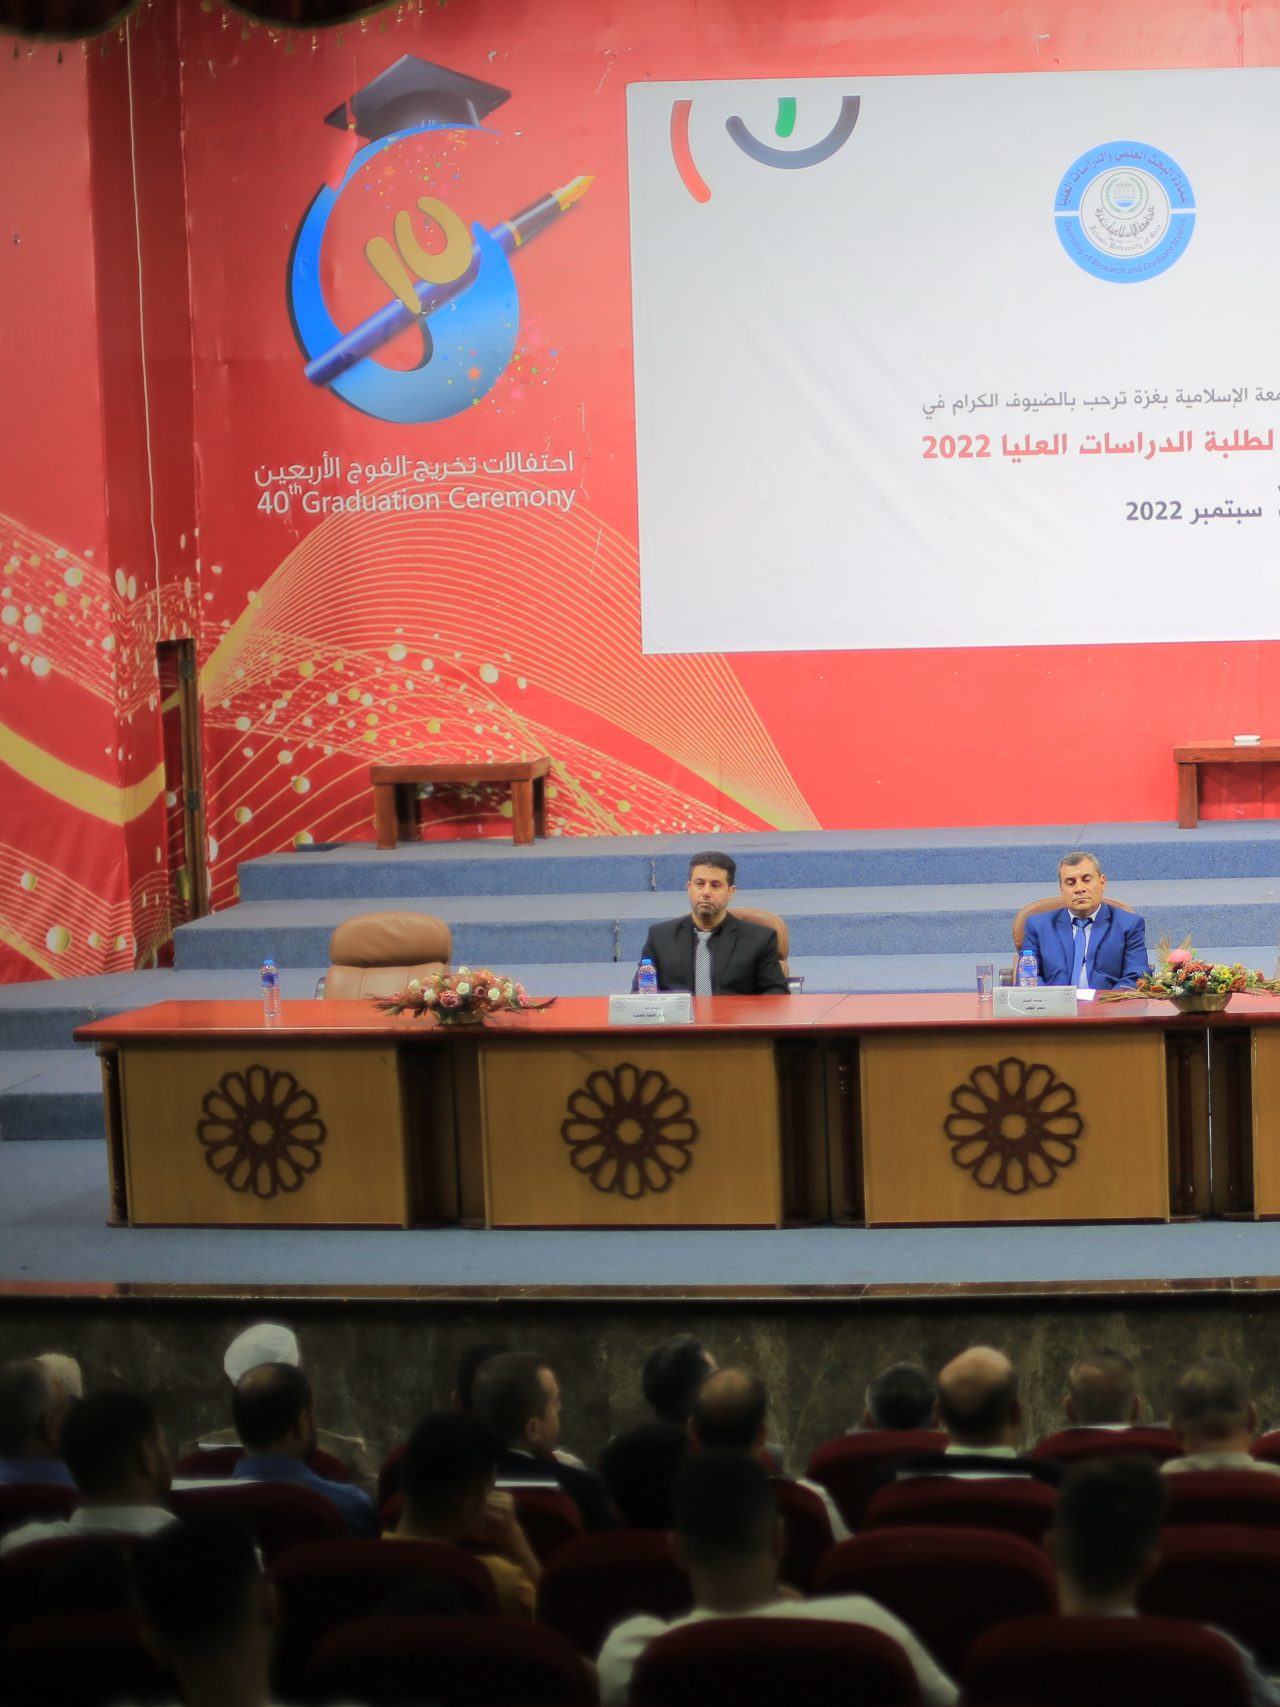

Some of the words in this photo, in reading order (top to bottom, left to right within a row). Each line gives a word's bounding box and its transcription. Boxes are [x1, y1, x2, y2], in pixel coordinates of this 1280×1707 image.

[923, 395, 944, 419] في
[953, 393, 998, 415] الكرام
[1006, 392, 1075, 412] بالضيوف
[1083, 392, 1126, 410] ترحب
[1134, 389, 1168, 409] بغزة
[1176, 388, 1247, 408] الإسلامية
[922, 434, 991, 459] 2022
[1002, 433, 1067, 463] العليا
[1079, 431, 1192, 460] الدراسات
[1205, 428, 1273, 459] لطلبة
[254, 451, 341, 487] الأربعين
[347, 454, 408, 484] الفوج
[413, 455, 477, 482] تخريج
[484, 450, 575, 475] احتفالات
[302, 487, 440, 513] Graduation
[448, 486, 576, 512] Ceremony
[1126, 501, 1182, 521] 2022
[1189, 500, 1262, 525] سبتمبر
